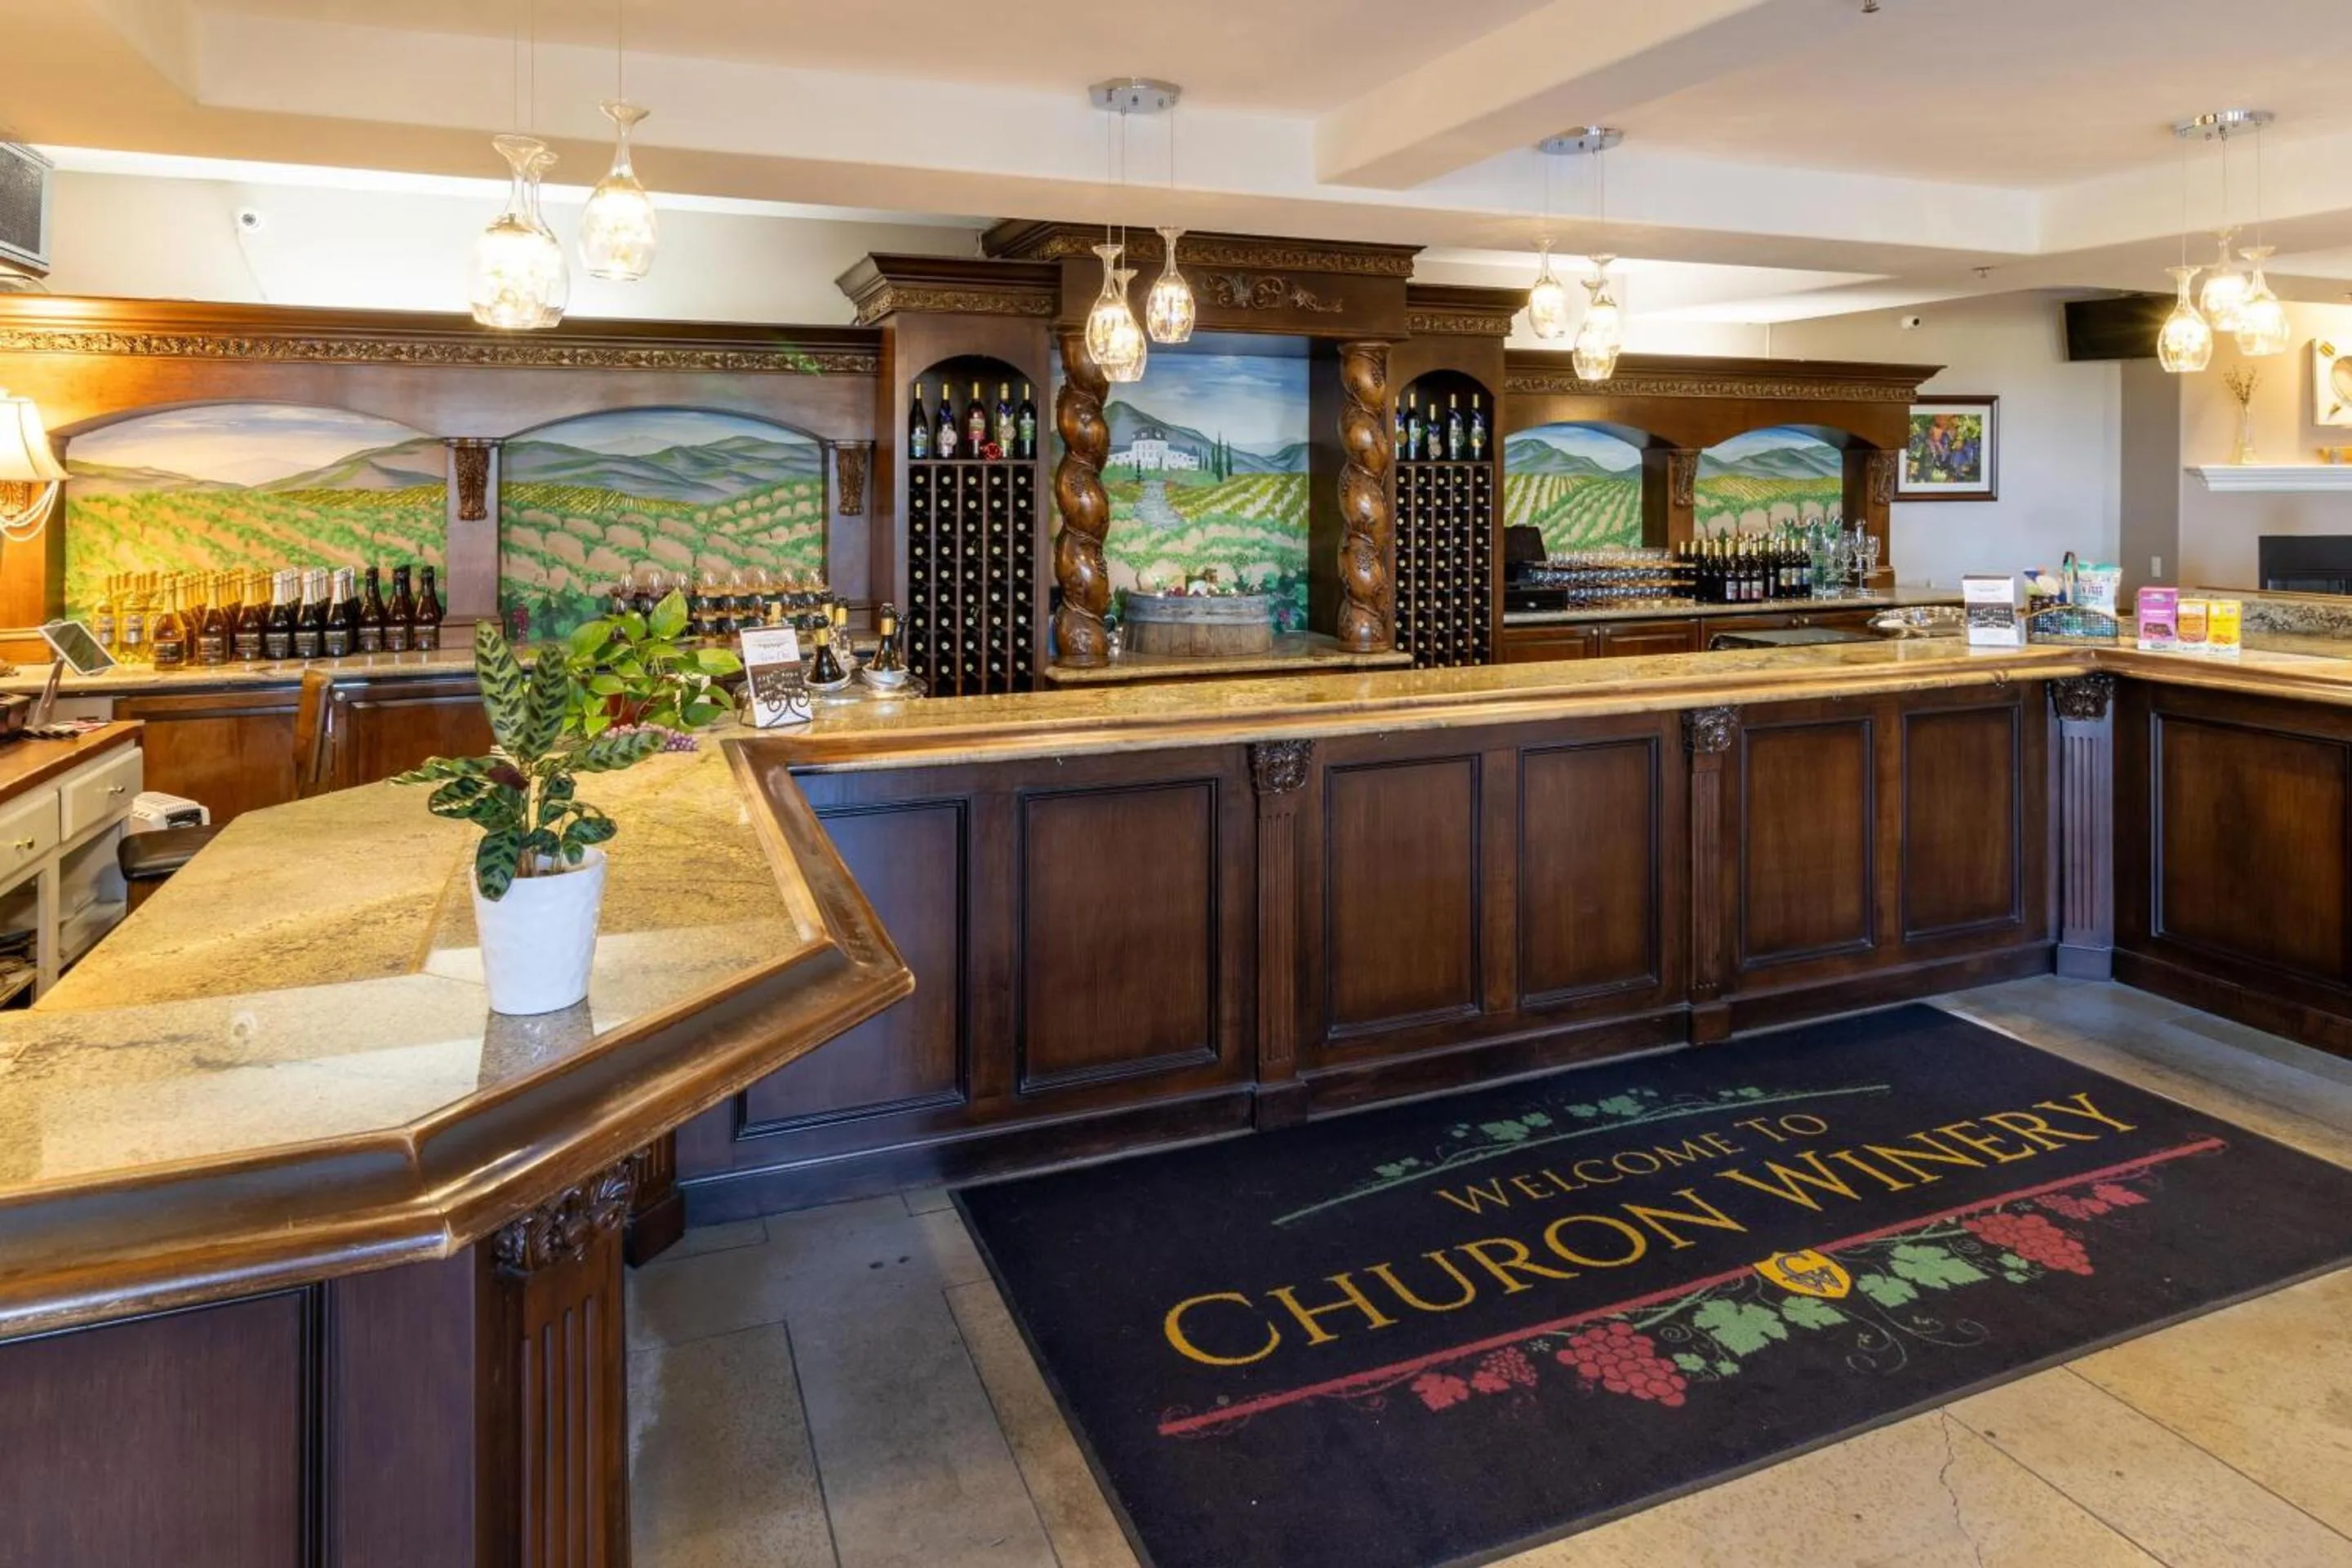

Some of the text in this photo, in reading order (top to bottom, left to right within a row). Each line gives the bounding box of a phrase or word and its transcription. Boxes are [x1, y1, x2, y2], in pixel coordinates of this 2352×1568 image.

[1163, 1091, 2136, 1366] CHURON WINERY
[1437, 1113, 1829, 1215] WELCOME TO
